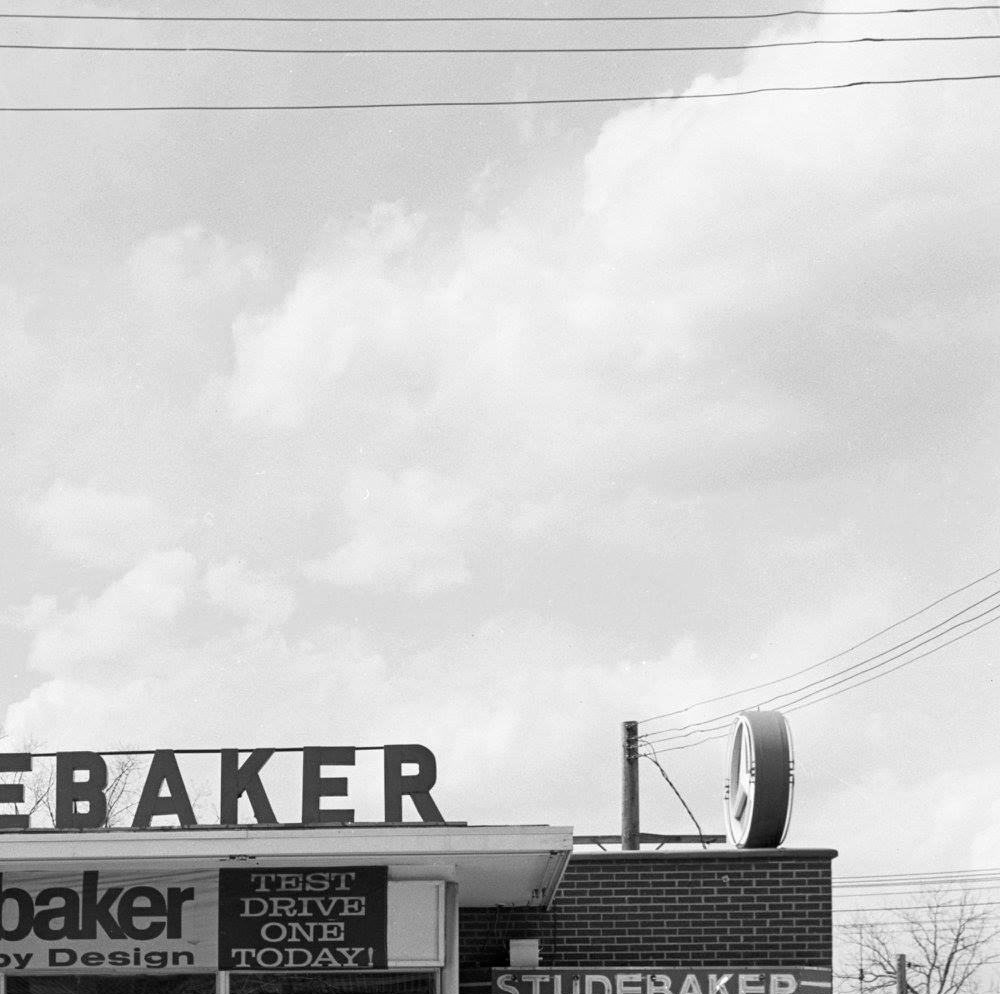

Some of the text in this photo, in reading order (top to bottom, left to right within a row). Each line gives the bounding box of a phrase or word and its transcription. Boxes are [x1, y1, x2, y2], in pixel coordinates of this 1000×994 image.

[251, 872, 355, 892] TEST
[240, 896, 366, 917] DRIVE
[261, 922, 345, 942] ONE
[49, 947, 194, 969] Design
[231, 947, 374, 968] TODAY!
